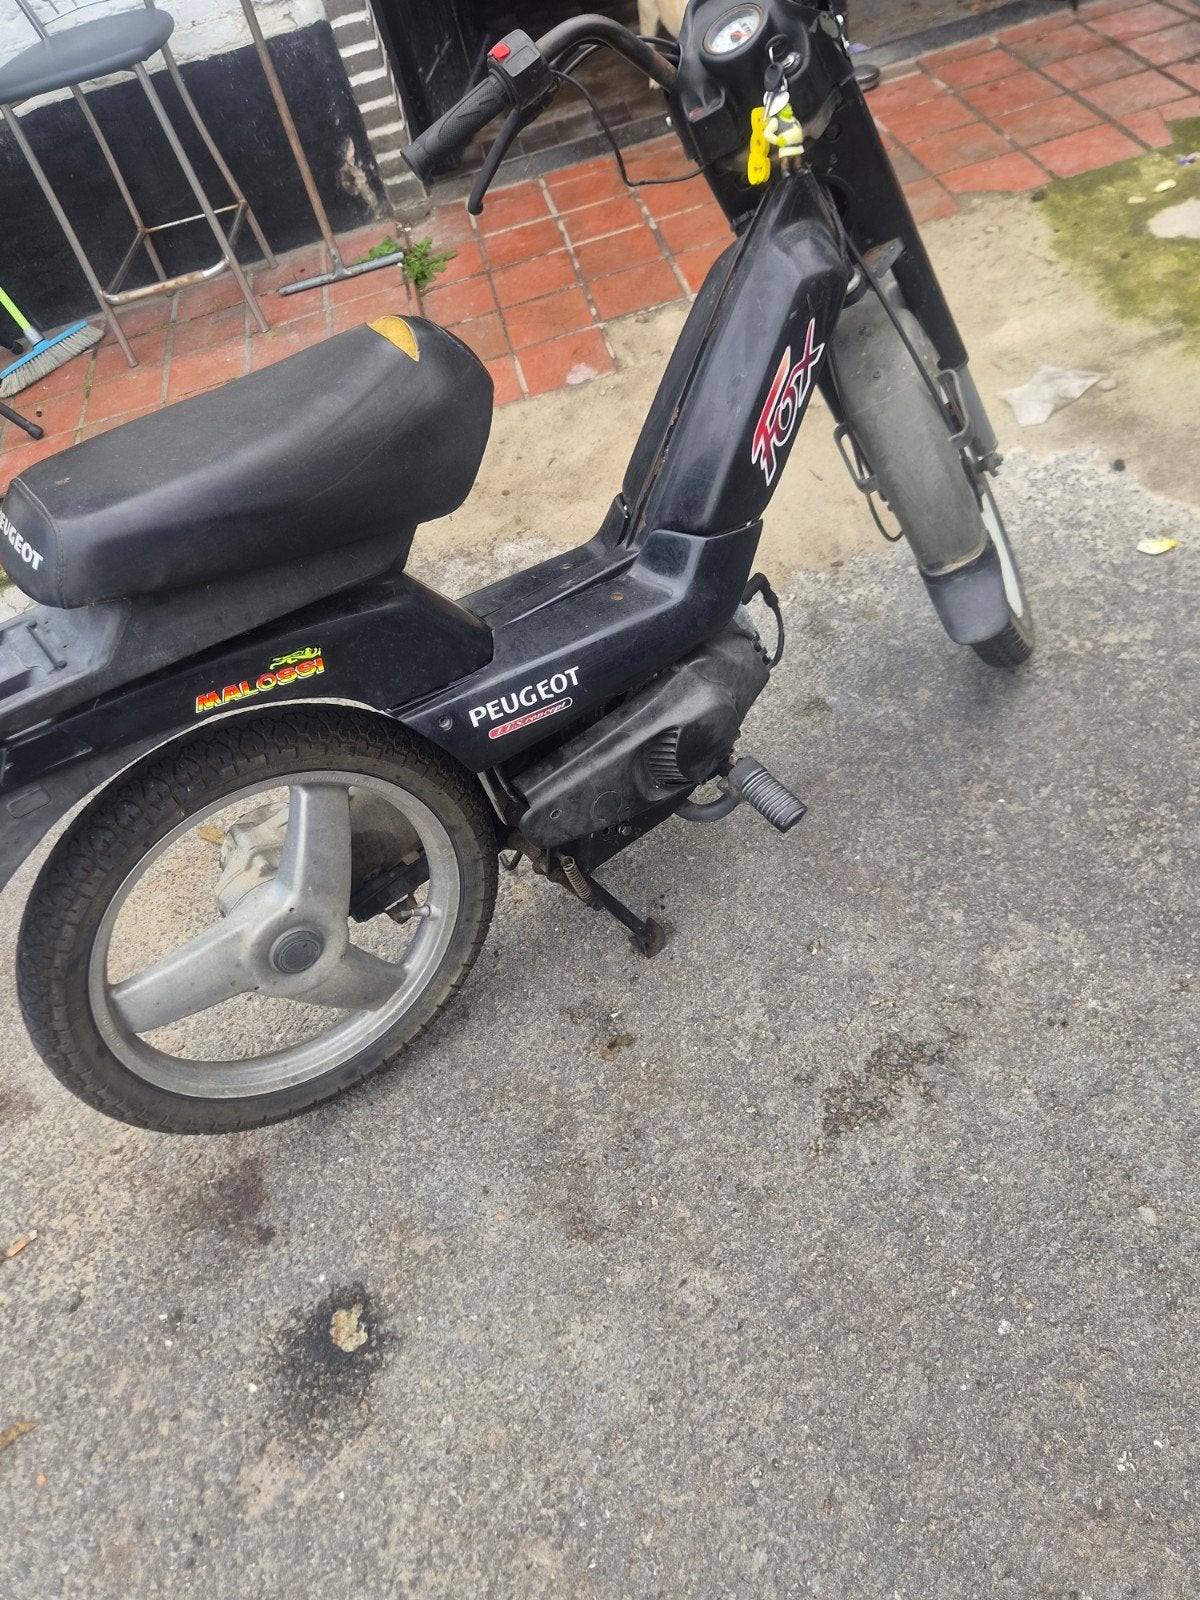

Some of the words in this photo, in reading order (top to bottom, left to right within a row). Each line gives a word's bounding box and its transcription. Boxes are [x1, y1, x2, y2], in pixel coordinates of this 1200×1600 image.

[0, 508, 43, 570] EUGEOT
[196, 657, 325, 713] MALOSSI
[468, 666, 579, 728] PEUGEOT
